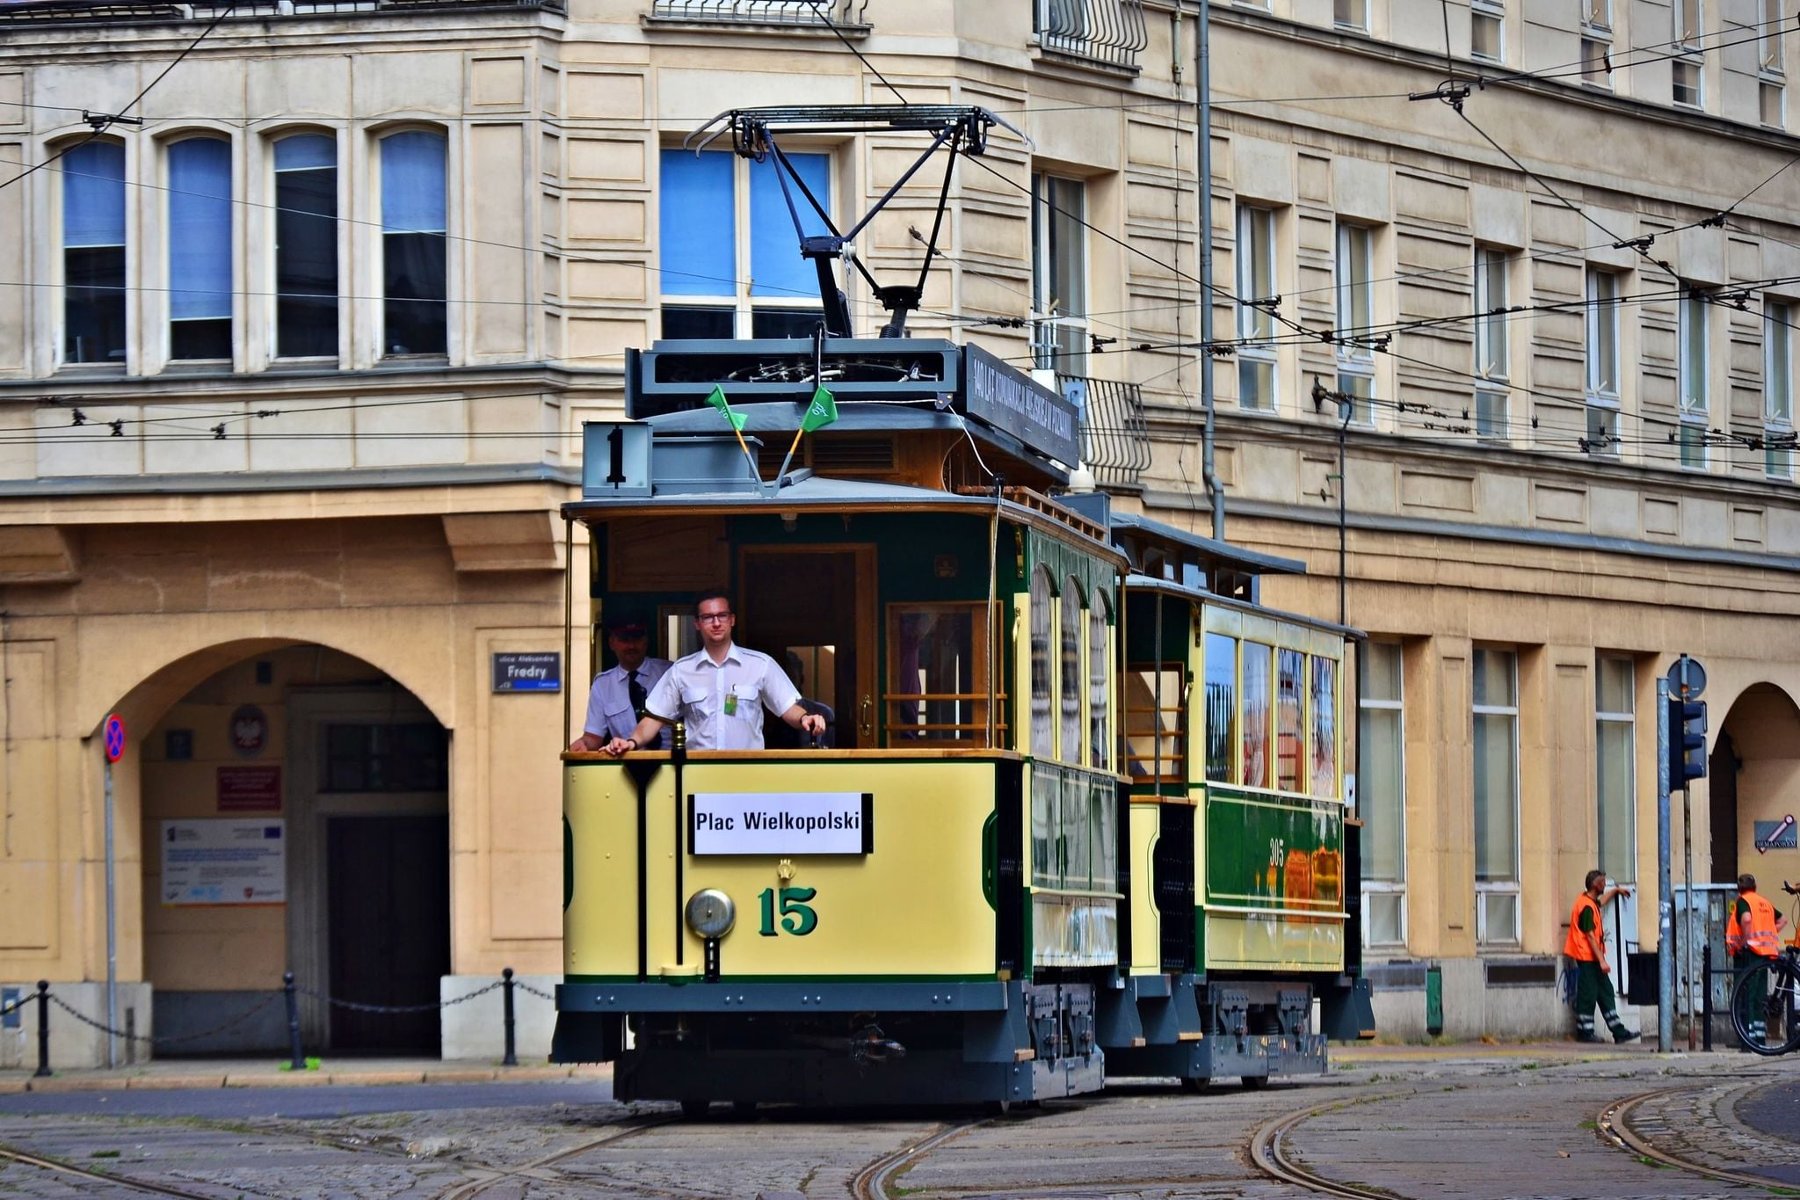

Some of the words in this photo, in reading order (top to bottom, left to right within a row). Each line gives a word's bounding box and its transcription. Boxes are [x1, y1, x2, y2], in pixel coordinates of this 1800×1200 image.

[606, 426, 627, 489] 1
[507, 665, 546, 680] Fredry
[696, 812, 734, 831] Plac
[743, 811, 860, 834] Wielkopolski
[1269, 837, 1284, 868] 305
[757, 886, 818, 937] 15
